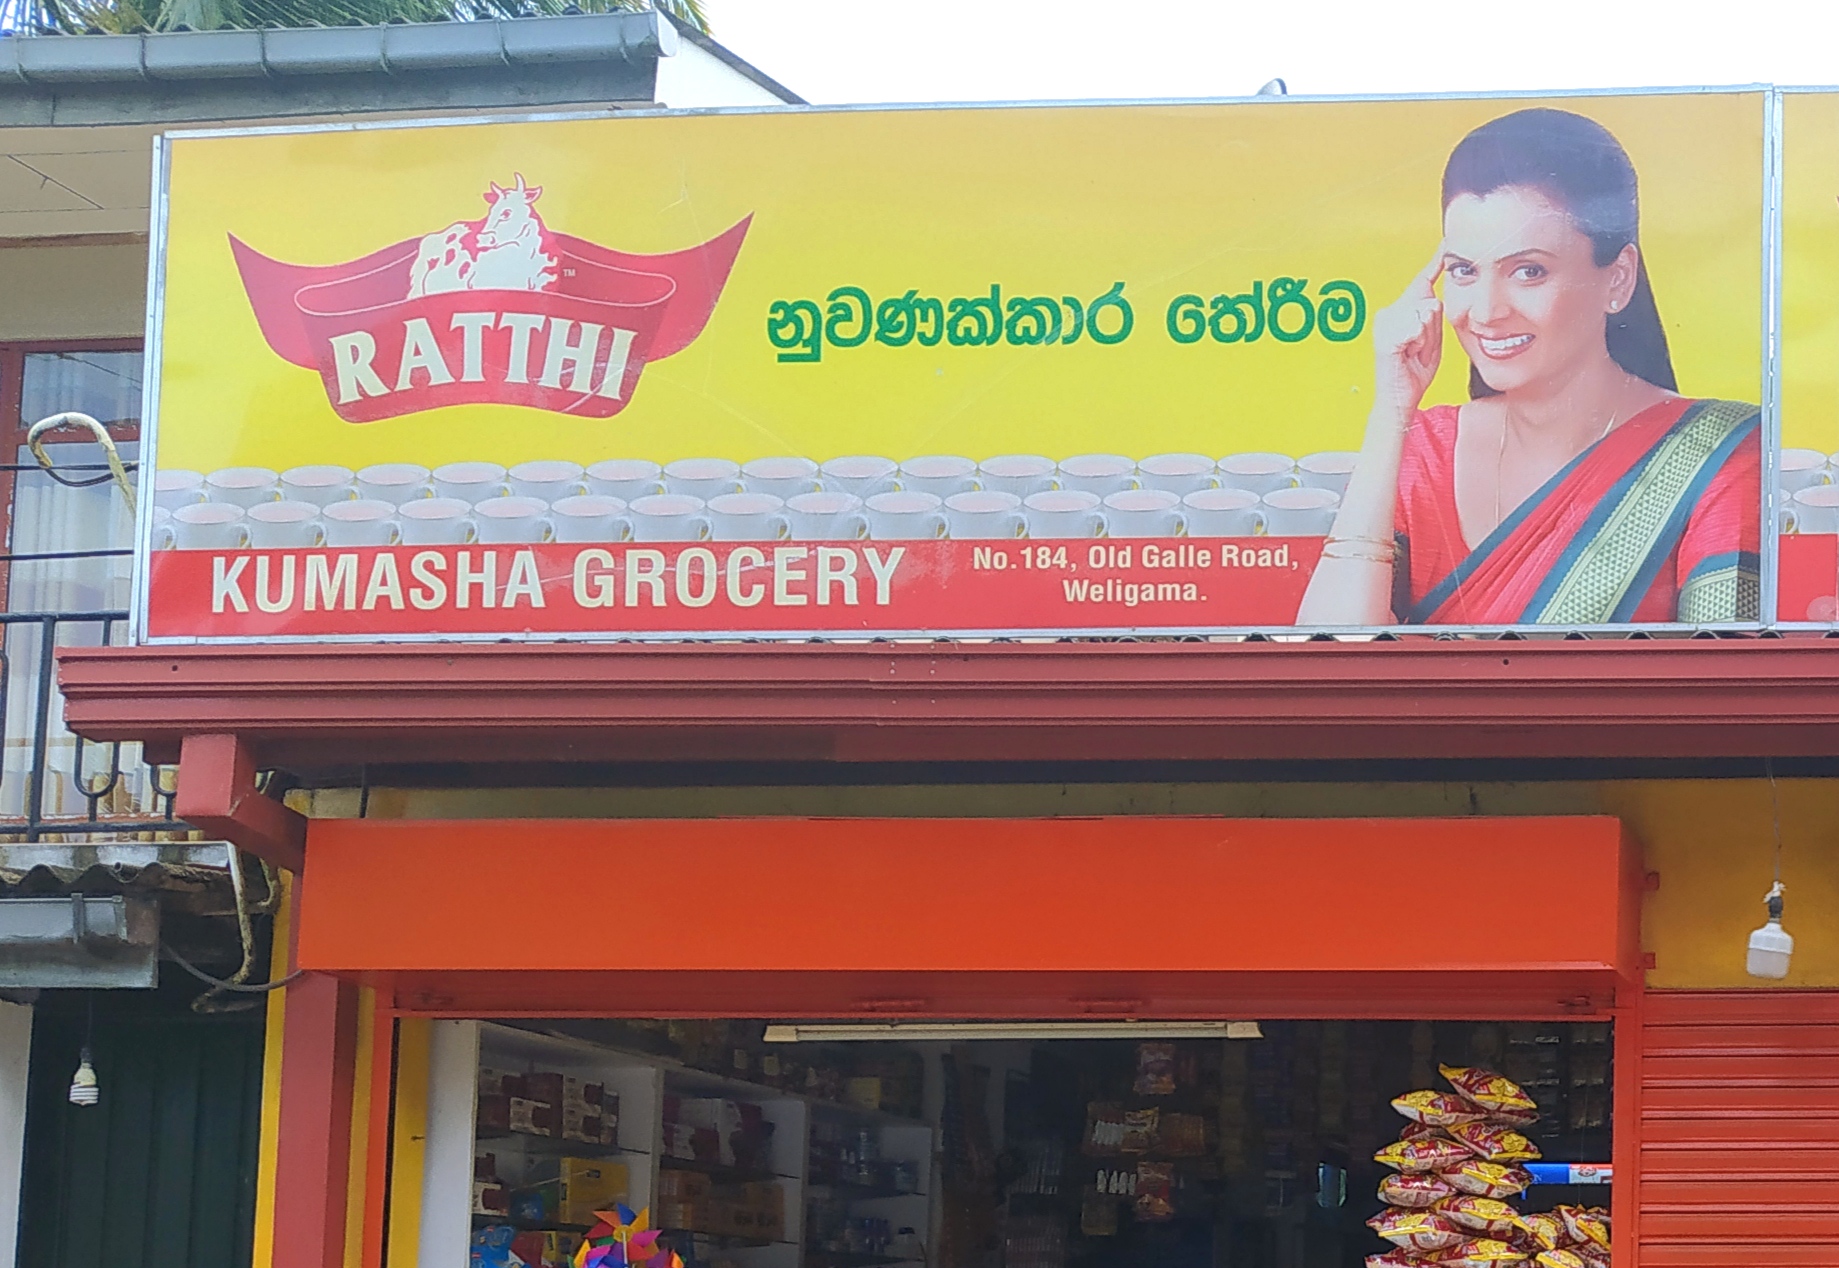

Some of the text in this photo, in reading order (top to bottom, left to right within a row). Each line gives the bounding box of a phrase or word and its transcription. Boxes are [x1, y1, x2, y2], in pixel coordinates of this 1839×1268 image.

[1166, 277, 1368, 345] තේරීම
[328, 310, 639, 406] RATTHI
[211, 545, 907, 614] KUMASHA GROCERY
[972, 543, 1300, 572] No.184, Old Galle Road,
[1062, 577, 1208, 607] Weligama.
